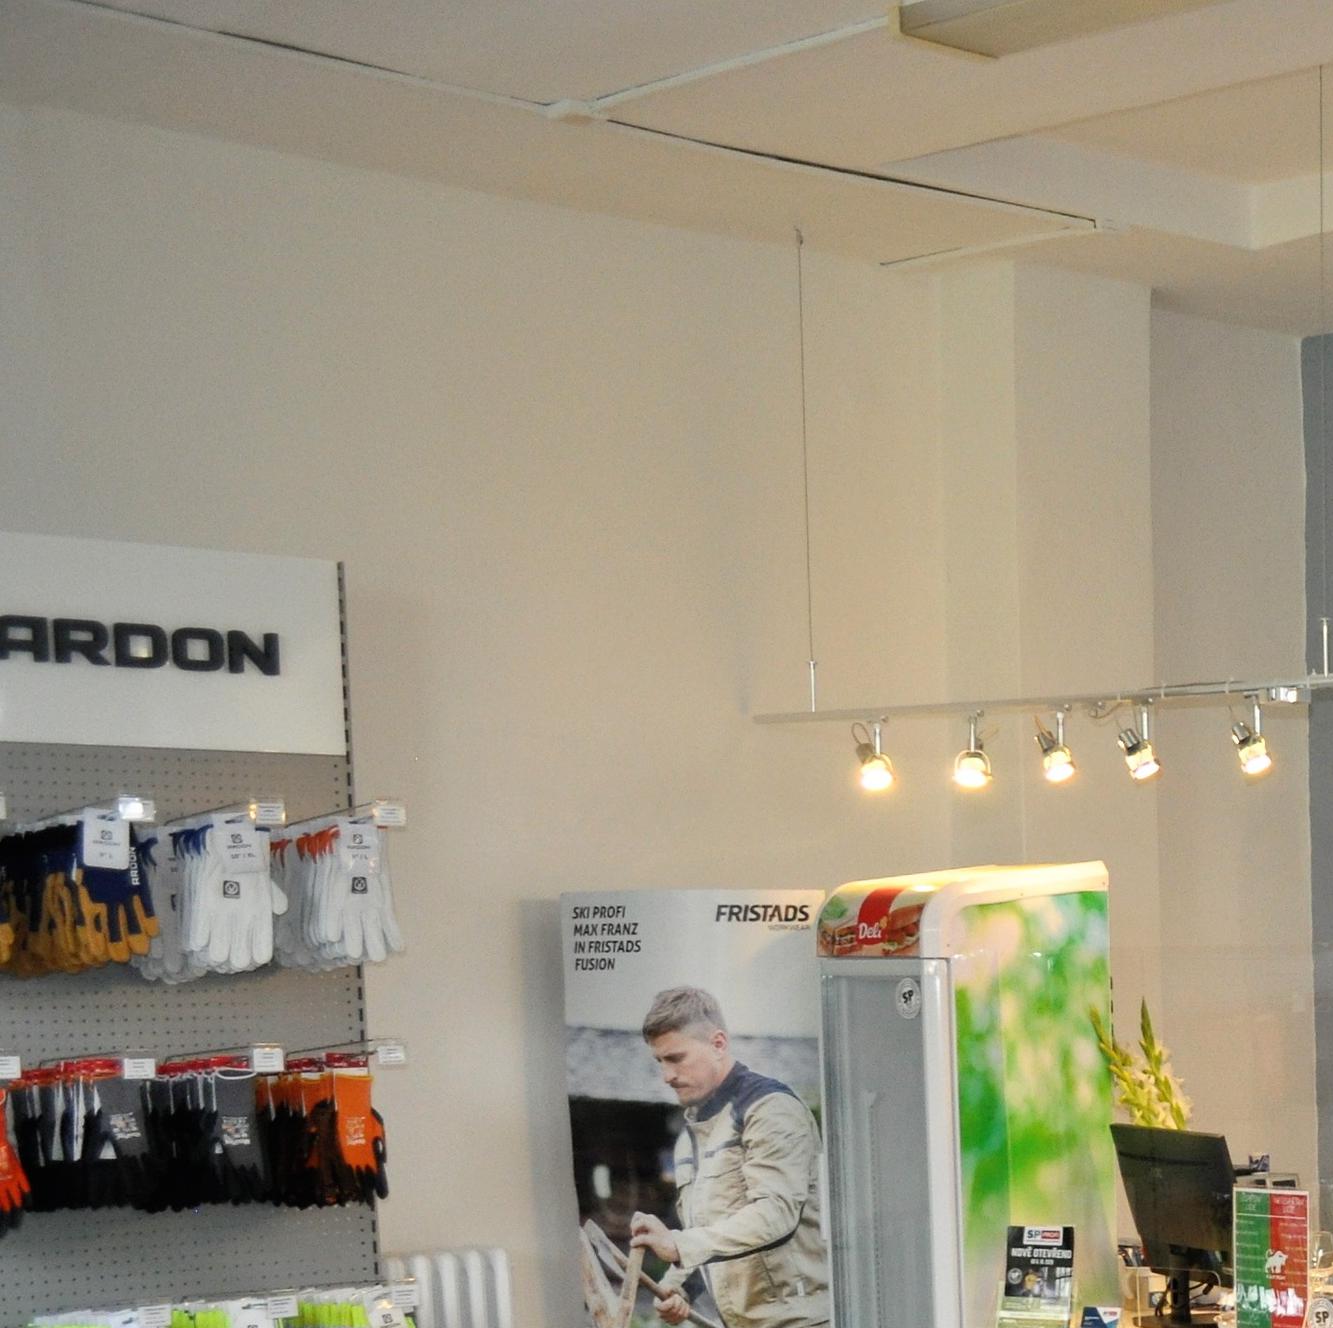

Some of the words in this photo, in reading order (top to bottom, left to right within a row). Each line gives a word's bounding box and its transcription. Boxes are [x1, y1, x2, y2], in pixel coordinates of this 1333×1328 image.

[0, 615, 280, 676] ARDON
[572, 906, 591, 919] SKI
[593, 905, 626, 919] PROFI
[715, 904, 810, 923] FRISTADS
[573, 924, 598, 937] MAX
[601, 922, 639, 936] FRANZ
[858, 921, 883, 940] Deli
[574, 942, 587, 954] IN
[589, 940, 642, 954] FRISTADS
[575, 958, 616, 972] FUSION
[1315, 1310, 1330, 1324] SP
